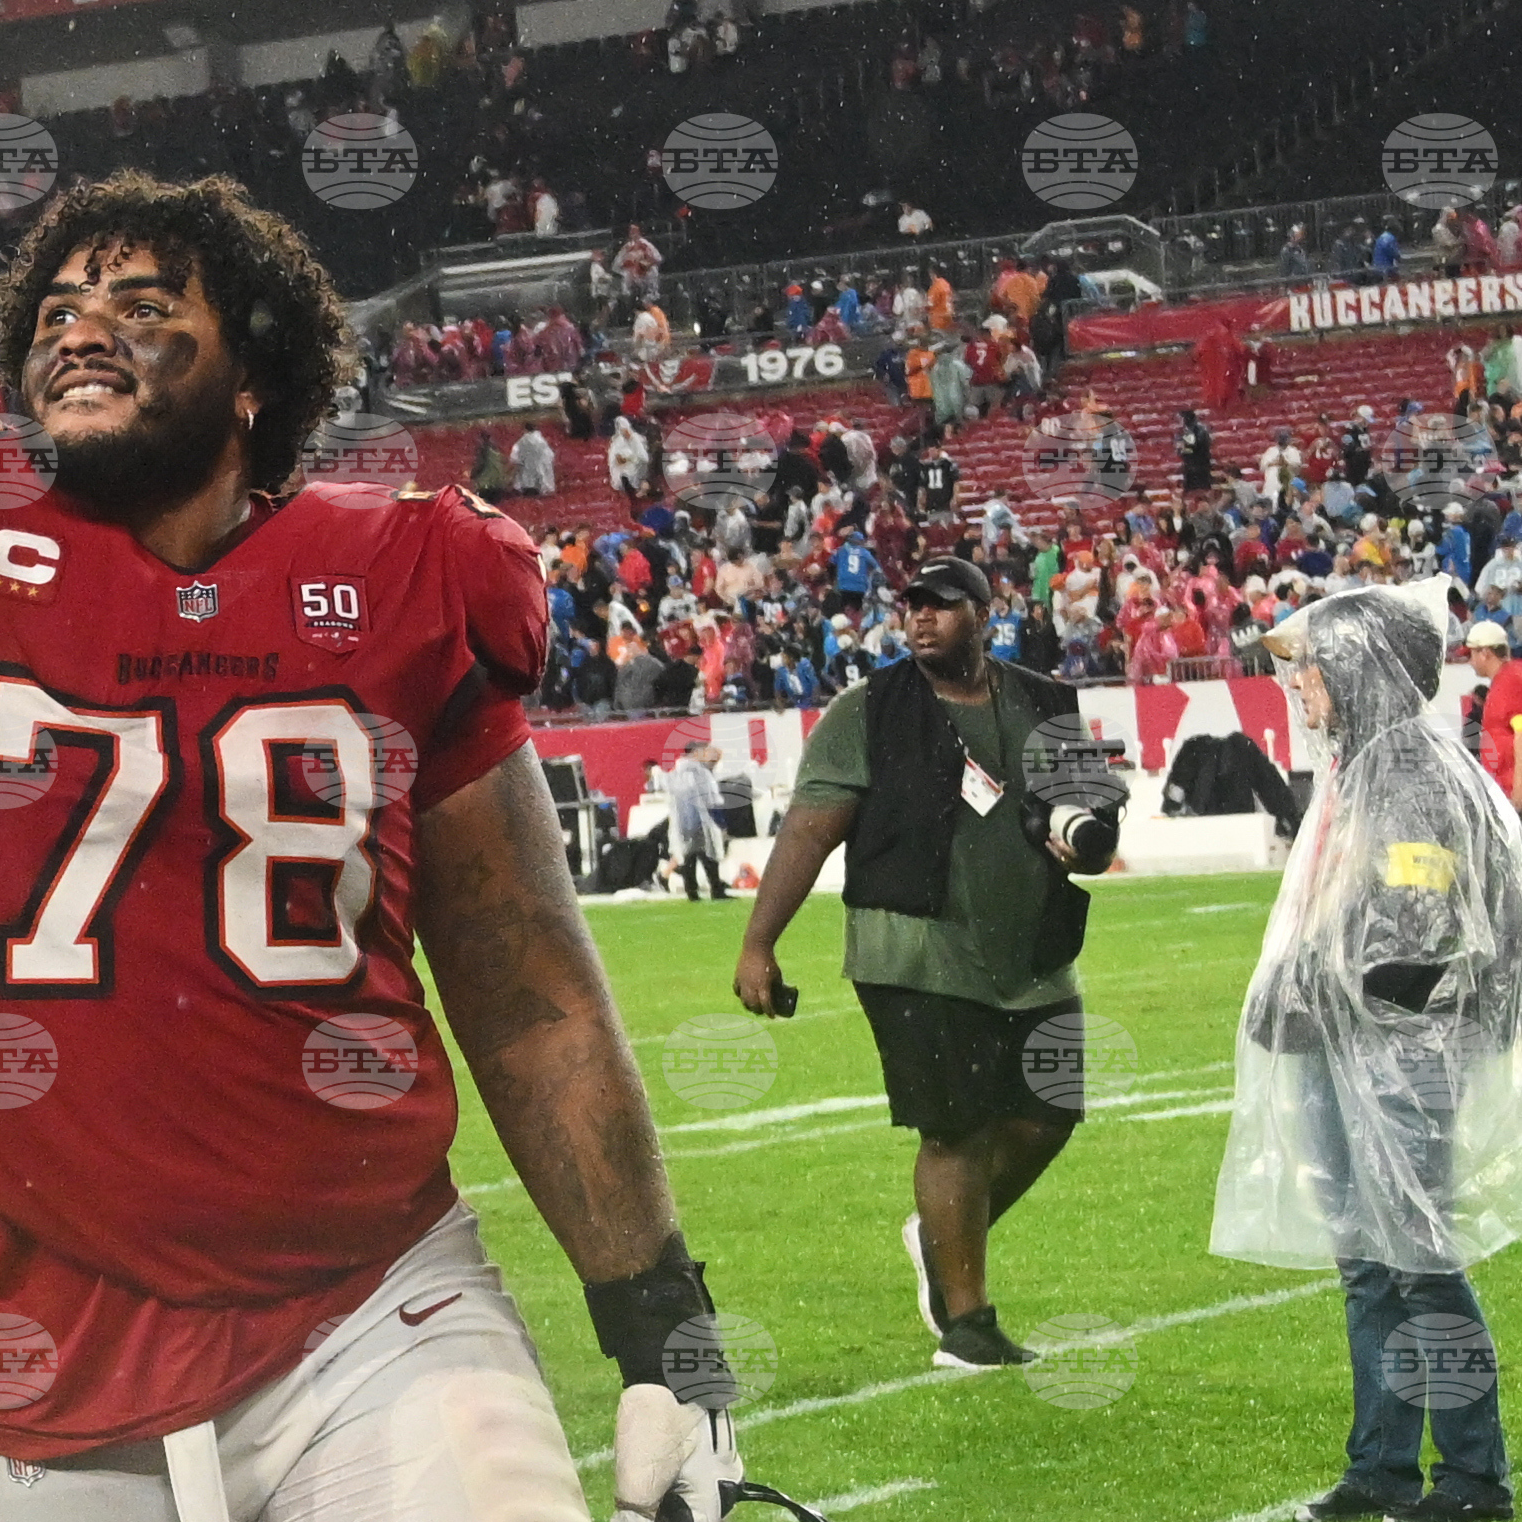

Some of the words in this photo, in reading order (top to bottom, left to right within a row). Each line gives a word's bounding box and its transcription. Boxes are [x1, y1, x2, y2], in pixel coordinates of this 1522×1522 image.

[1289, 272, 1522, 332] BUCCANEERS
[506, 371, 574, 410] ES
[740, 343, 844, 384] 1976
[184, 598, 214, 614] NFL
[300, 582, 360, 620] 50
[116, 651, 280, 686] BUCCANEERS
